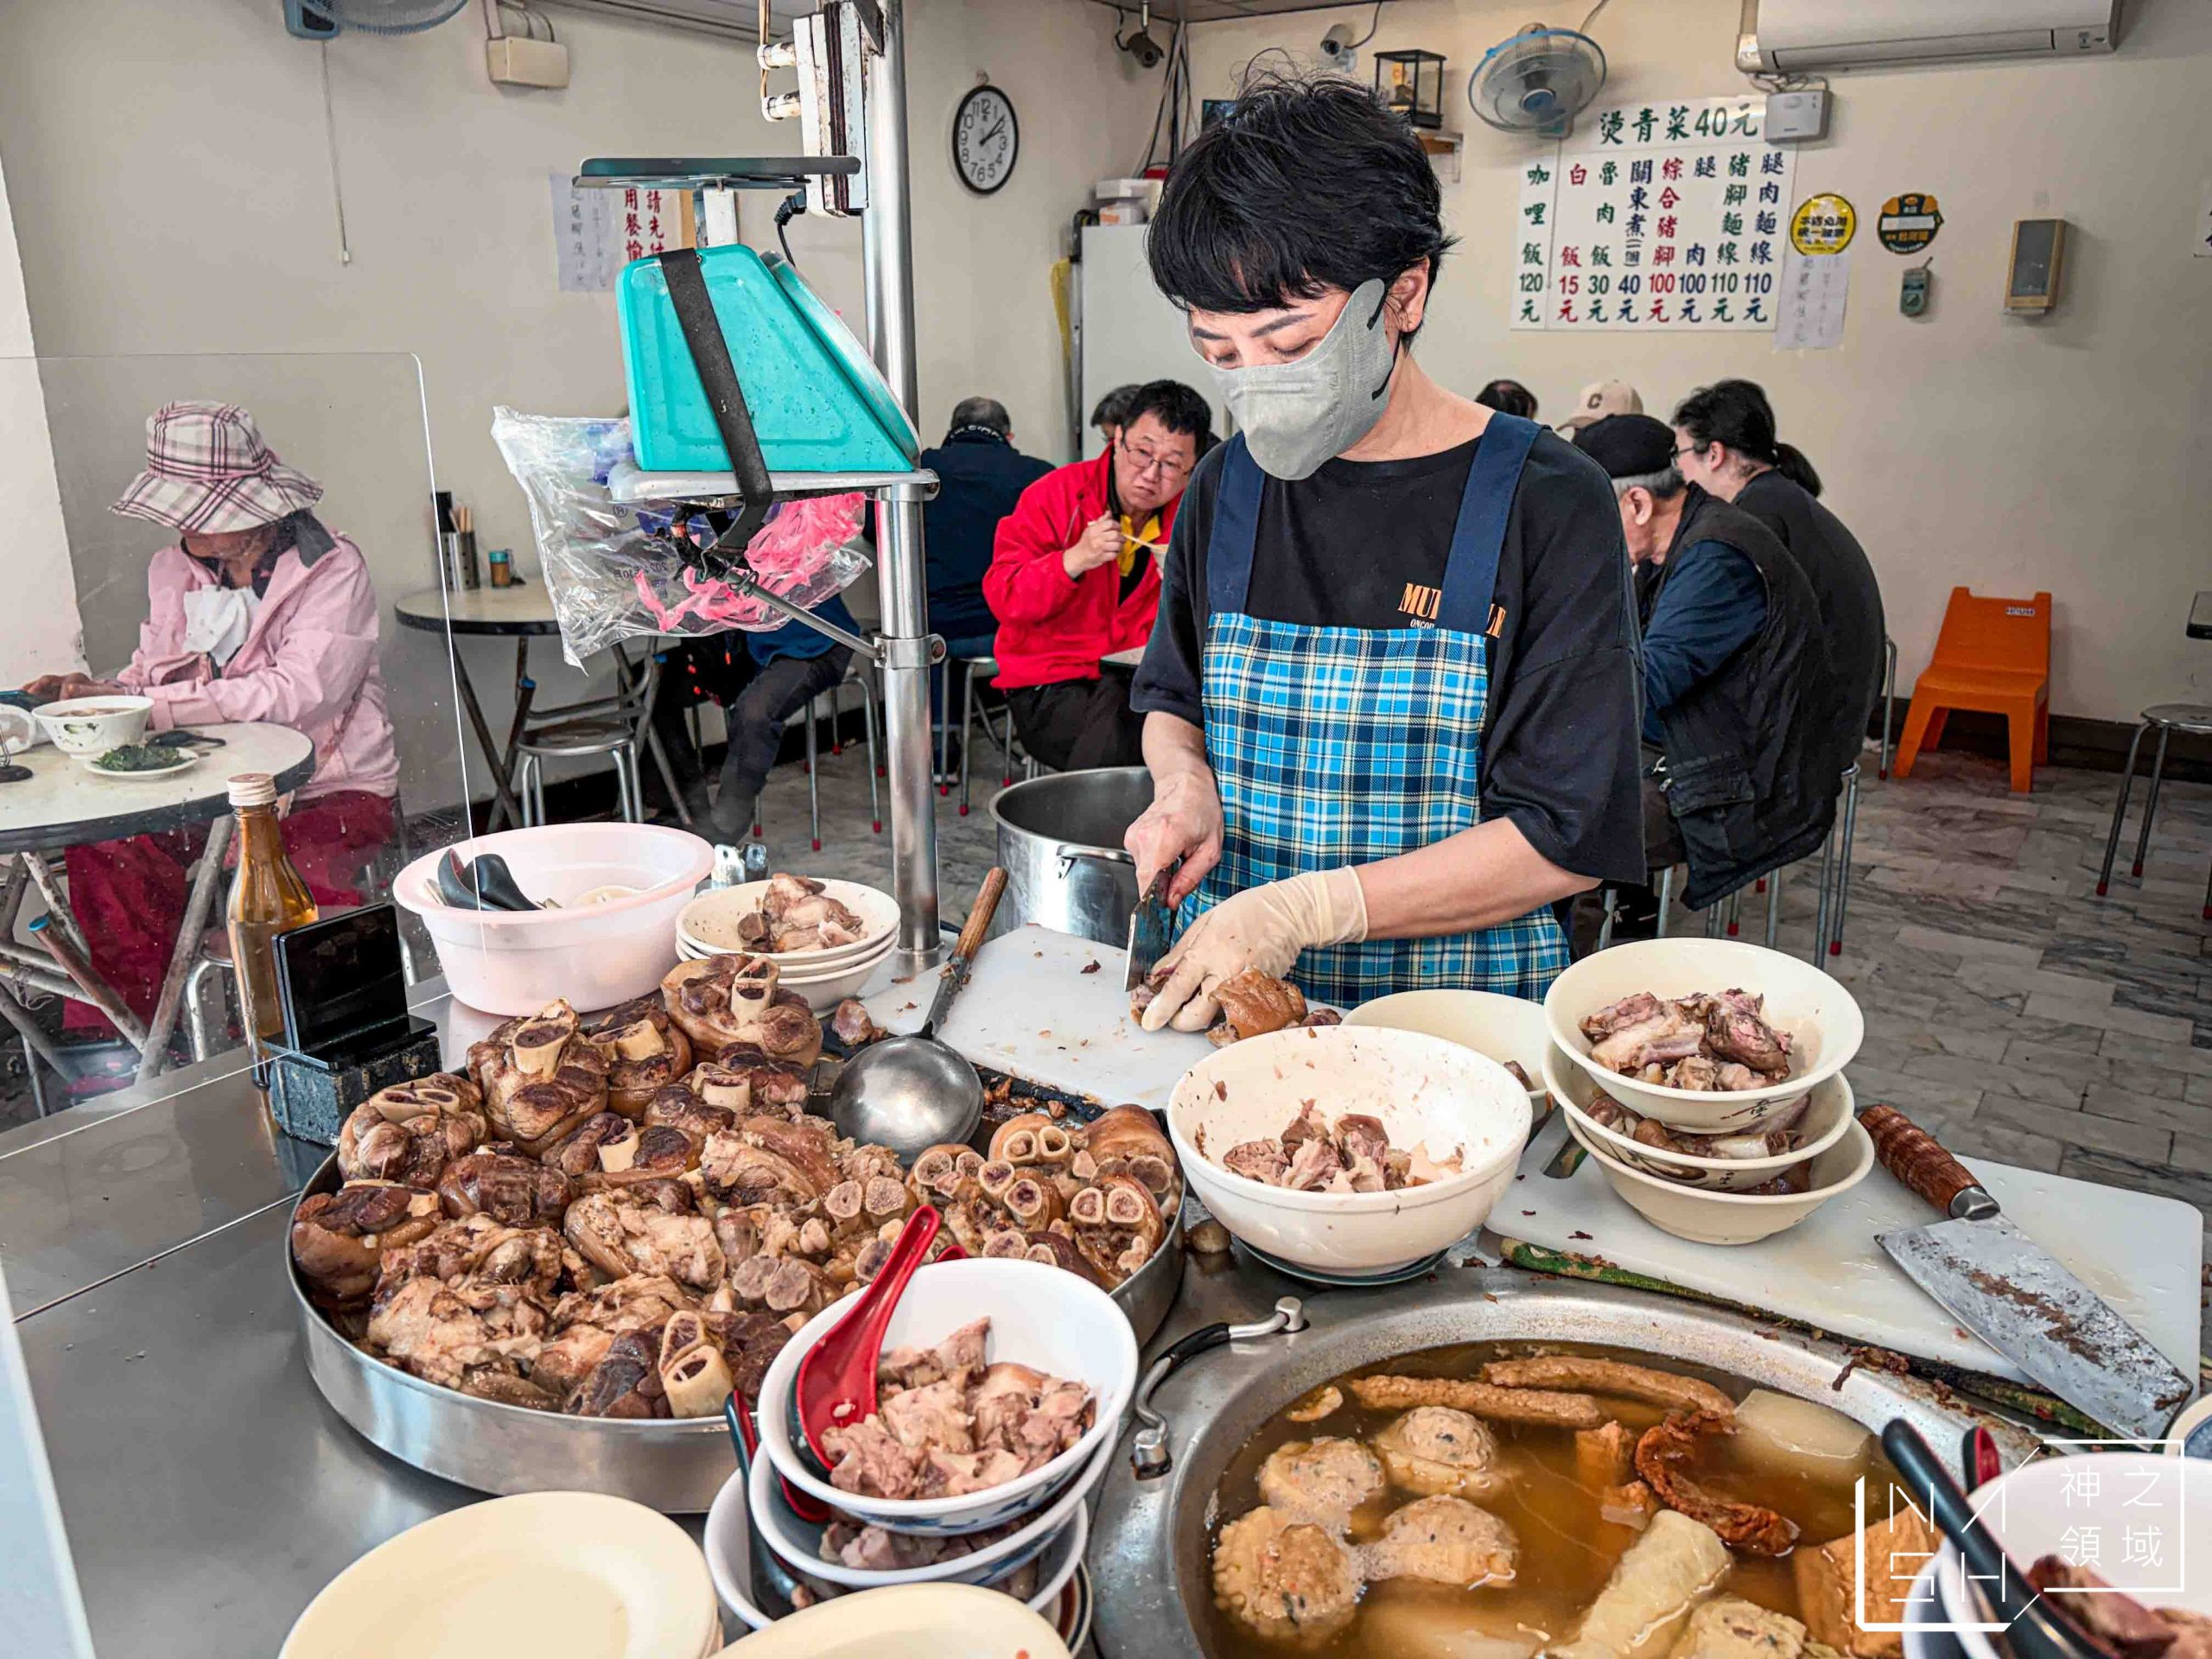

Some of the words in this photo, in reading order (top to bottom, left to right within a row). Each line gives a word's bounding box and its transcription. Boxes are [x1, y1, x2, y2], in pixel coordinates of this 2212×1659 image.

[1600, 103, 1758, 145] 燙青菜40元
[1587, 393, 1602, 409] C
